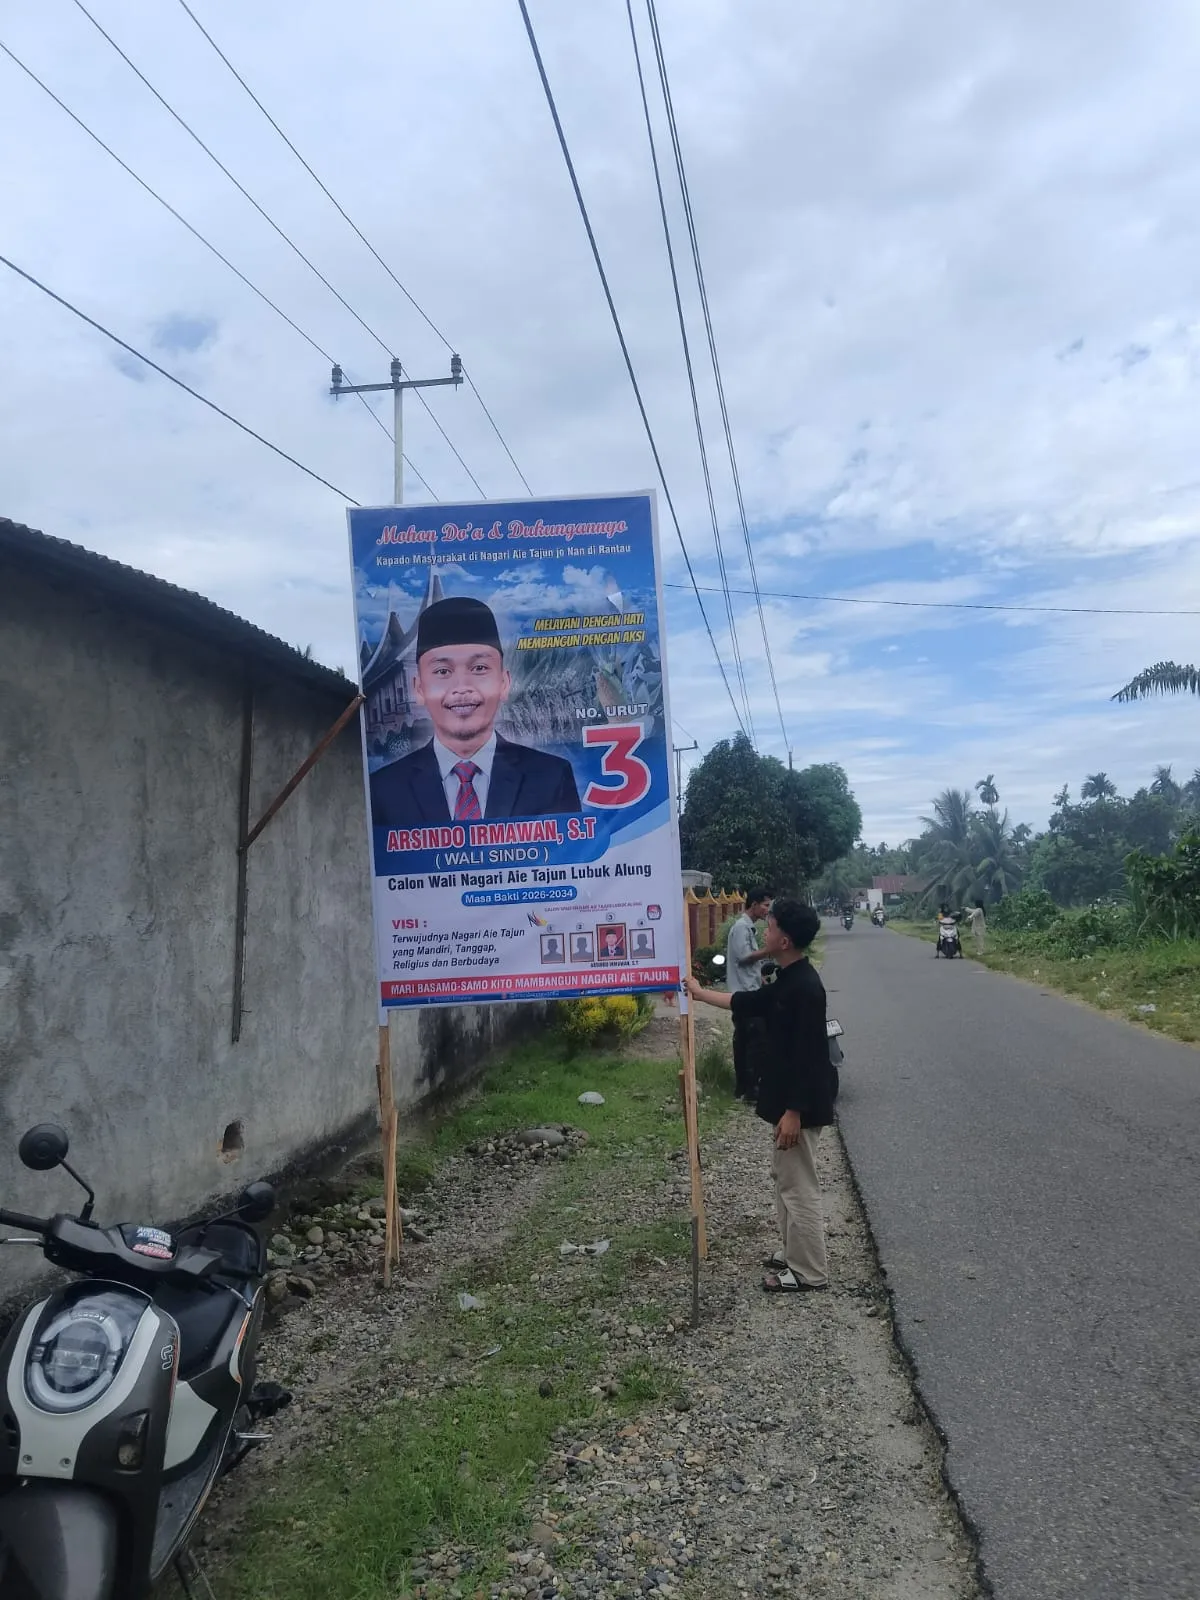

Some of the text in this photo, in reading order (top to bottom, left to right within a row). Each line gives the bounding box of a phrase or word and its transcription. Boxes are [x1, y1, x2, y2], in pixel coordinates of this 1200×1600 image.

[376, 525, 437, 545] Mohon
[488, 521, 503, 539] &
[507, 519, 628, 541] Dukungannyo
[376, 544, 631, 567] Kapado Masyarakat di Nagari Aie Tajun jo Nan di Rantau
[534, 613, 644, 632] MELAYANI DENGAN HATI
[516, 631, 645, 650] MEMBANGUN DENGAN AKSI
[576, 703, 648, 719] NO. URUT
[582, 722, 652, 808] 3
[387, 818, 597, 852] ARSINDO IRMAWAN, S.T
[444, 851, 484, 866] WALI
[489, 848, 539, 863] SINDO
[388, 863, 652, 891] Calon Wali Nagari Aie Tajun Lubuk Alung
[465, 889, 573, 904] Masa Bakti 2026-2034
[392, 919, 418, 929] VISI
[392, 928, 525, 944] Terwujudnya Nagari Aie Tajun
[393, 943, 496, 958] yang Mandiri, Tanggap,
[393, 956, 499, 970] Religius dan Berbudaya
[391, 971, 669, 995] MARI BASAMO-SAMO KITO MAMBANGUN NAGARI AIE TAJUN
